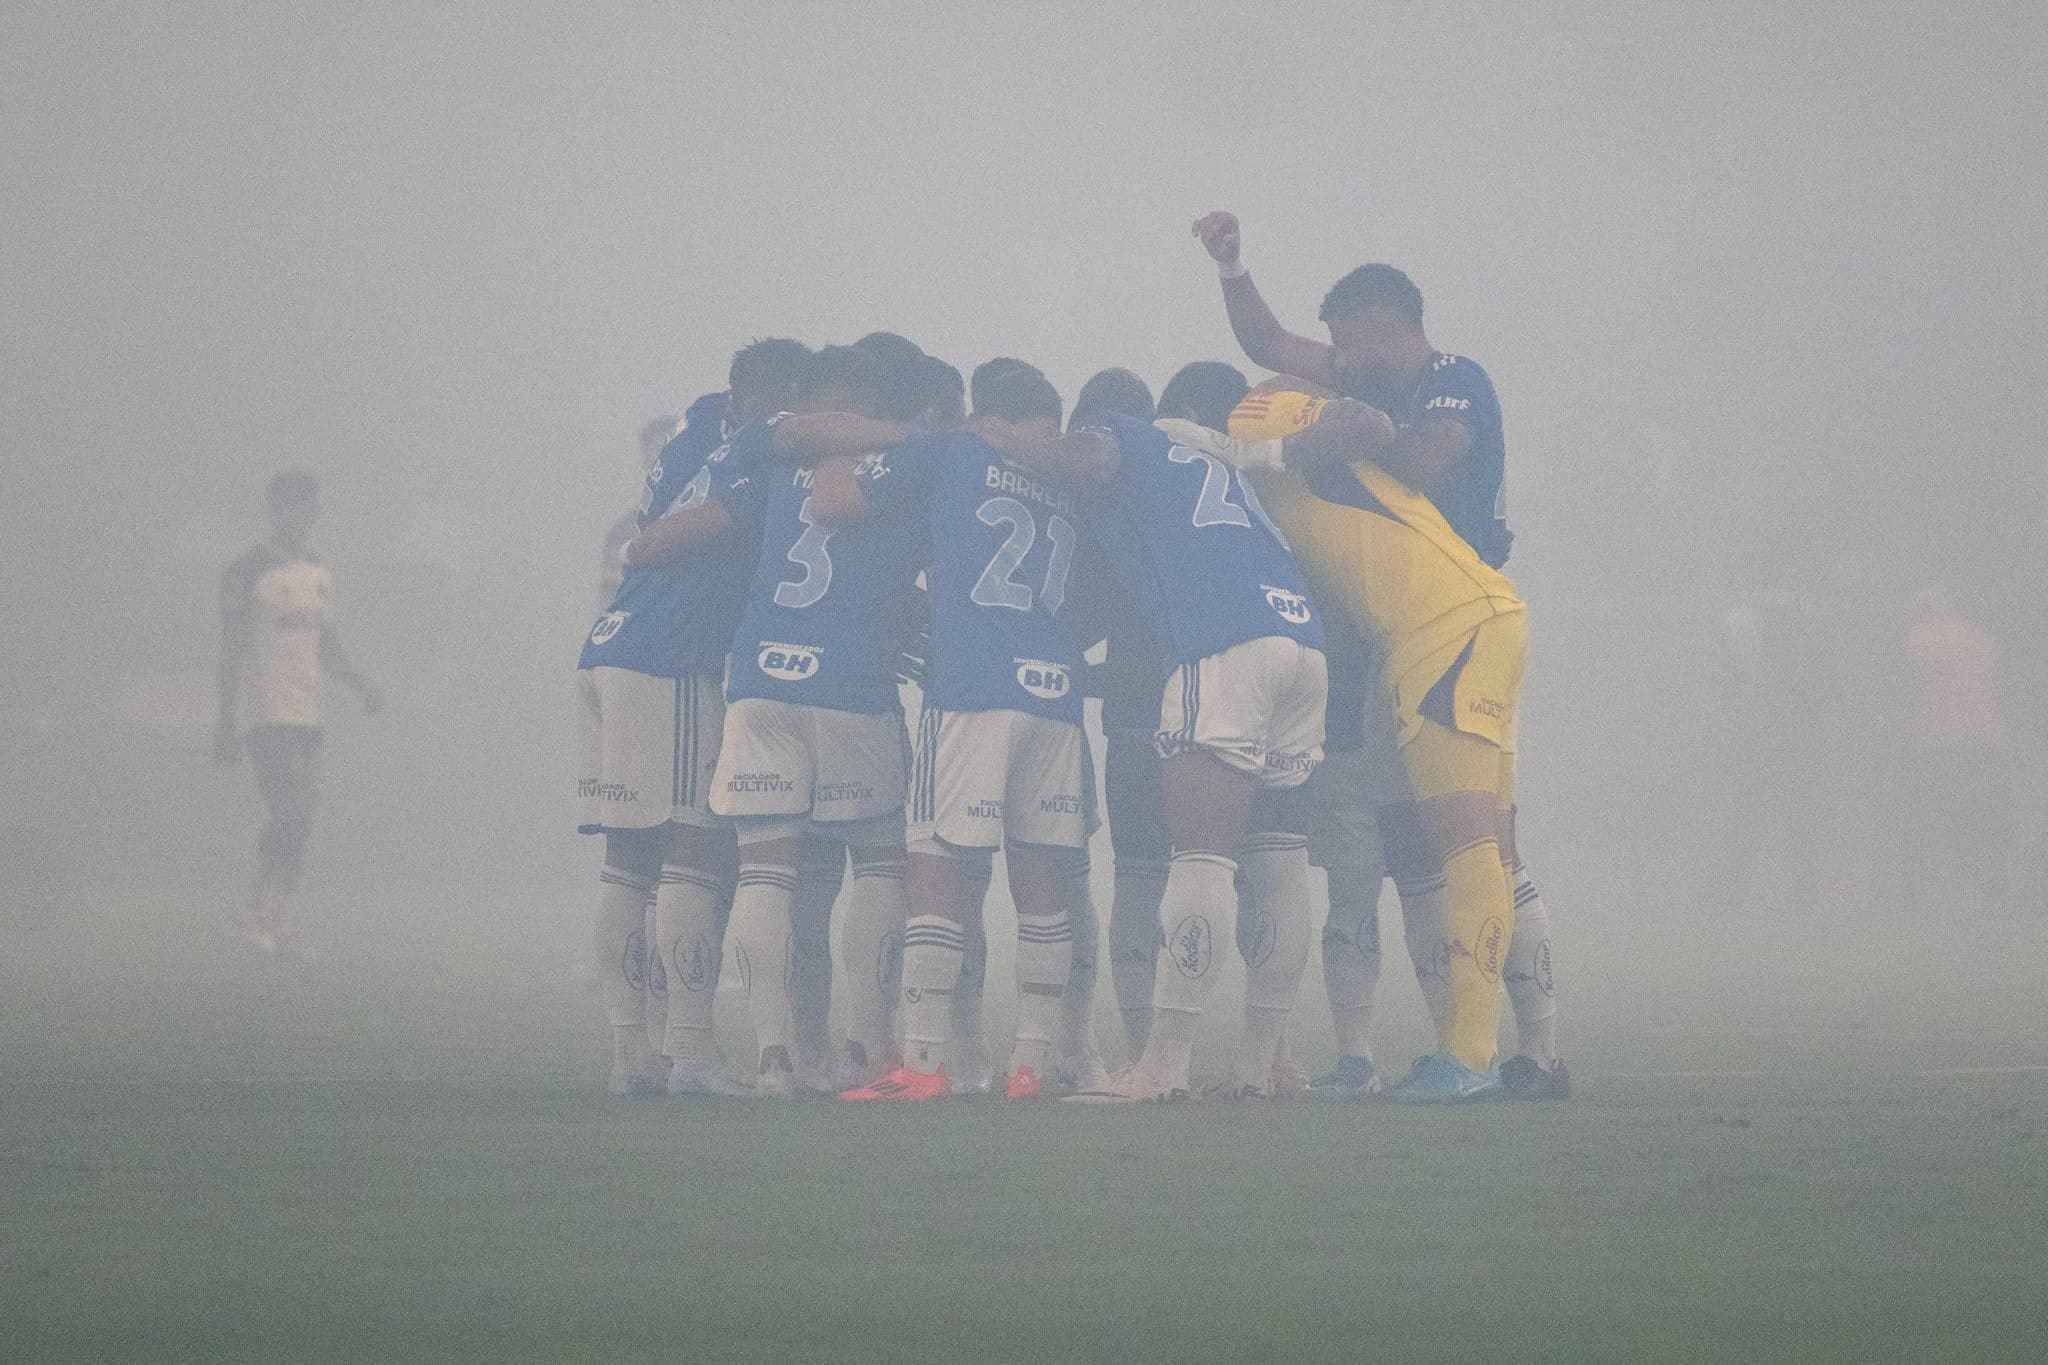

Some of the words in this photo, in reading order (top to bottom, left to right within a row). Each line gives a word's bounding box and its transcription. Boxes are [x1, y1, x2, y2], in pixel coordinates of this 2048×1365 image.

[774, 496, 833, 609] 3
[970, 497, 1077, 616] 21
[1272, 594, 1305, 619] BH
[763, 651, 812, 675] BH
[1024, 669, 1064, 692] BH
